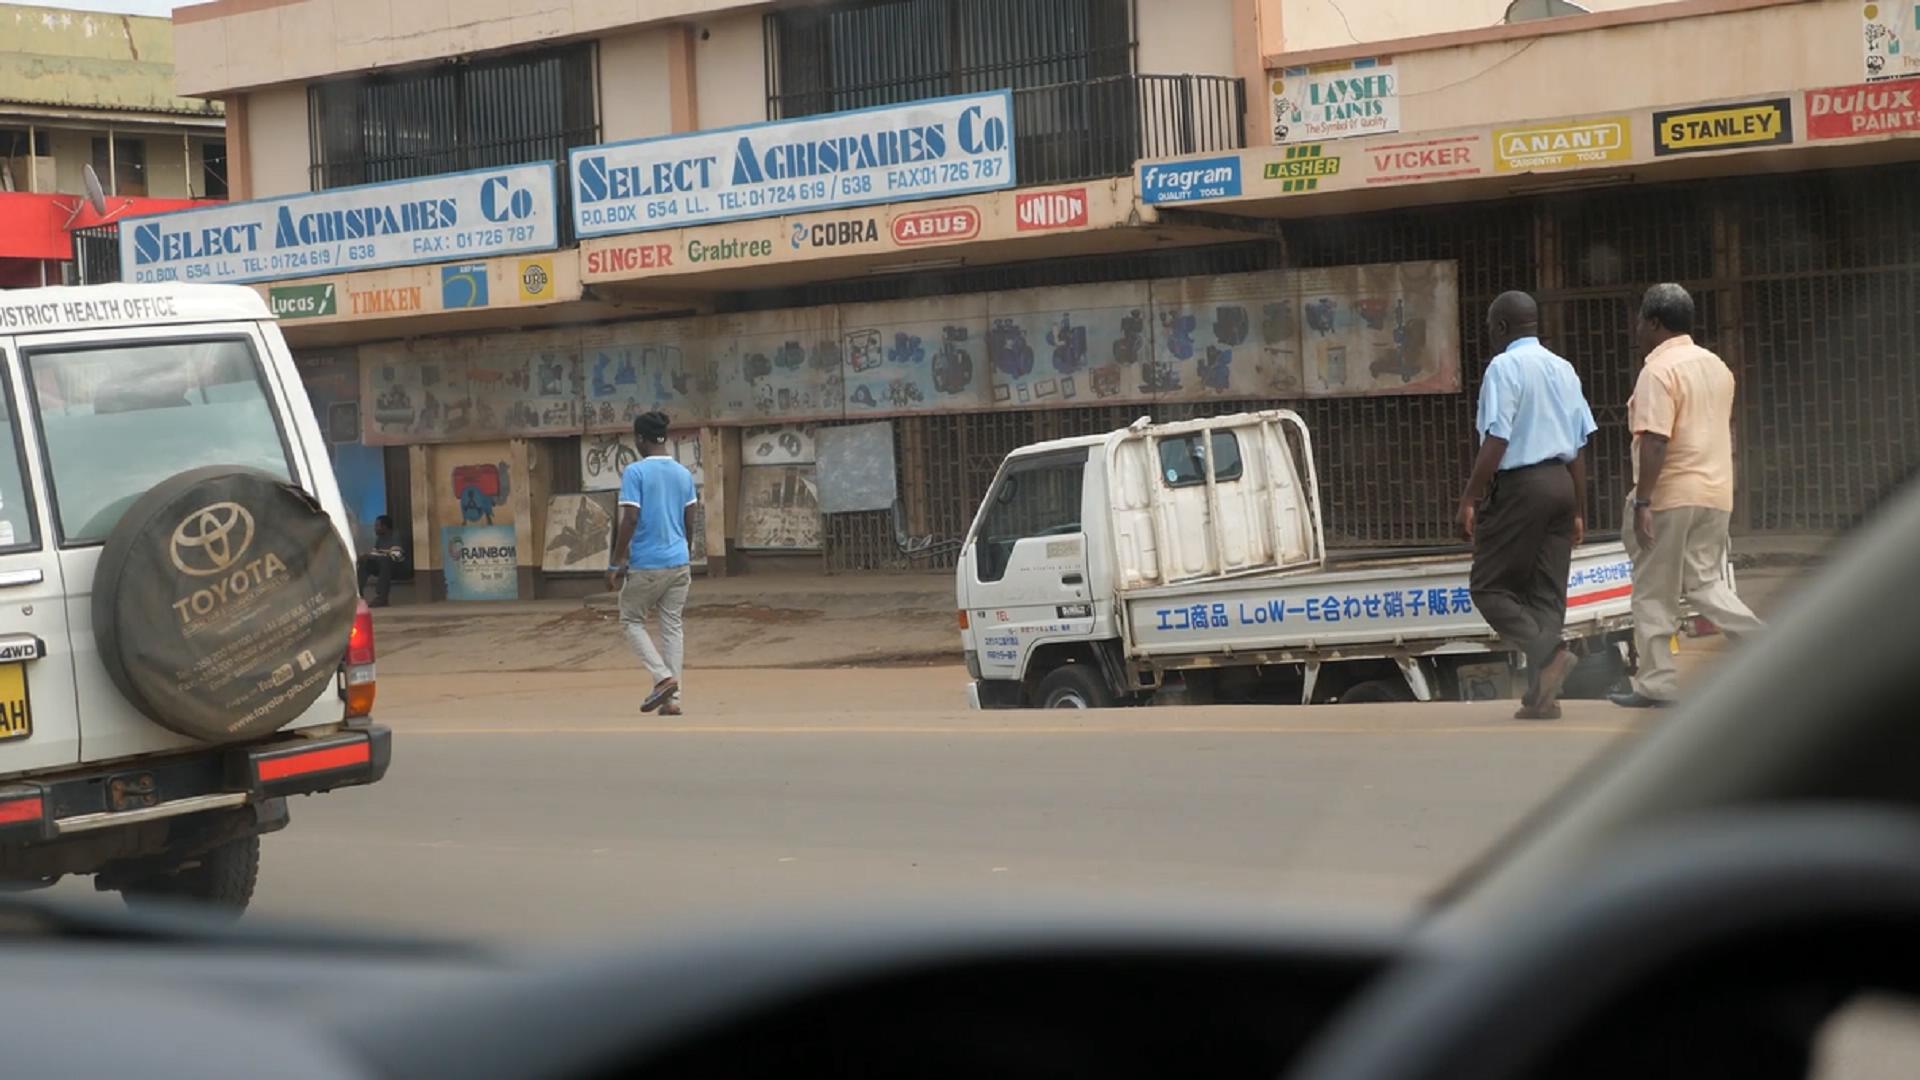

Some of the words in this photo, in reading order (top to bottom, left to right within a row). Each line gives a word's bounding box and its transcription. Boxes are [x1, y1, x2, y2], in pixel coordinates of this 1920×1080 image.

[1310, 74, 1397, 105] LAYSER
[1325, 100, 1382, 121] PAINTS
[1811, 90, 1913, 117] Dulux
[1306, 123, 1321, 134] The
[1671, 113, 1772, 141] STANLEY
[1509, 129, 1610, 154] ANANT
[579, 156, 717, 204] SELECT
[732, 124, 946, 186] AGRISPARES
[1266, 158, 1338, 178] LASHER
[1374, 147, 1470, 172] VICKER
[1510, 154, 1563, 168] CARPENTRY
[1576, 150, 1607, 161] TOOLS
[581, 204, 637, 226] P.O.BOX
[647, 199, 678, 218] 654
[686, 197, 709, 214] LL.
[800, 181, 825, 200] 619
[842, 174, 872, 195] 638
[973, 157, 1002, 179] 787
[1145, 166, 1232, 191] fragram
[1158, 190, 1192, 201] QUALITY
[1200, 187, 1225, 198] TOOLS
[1019, 194, 1082, 226] UNION
[134, 222, 262, 265] SELECT
[275, 198, 457, 249] AGRISPARES
[811, 218, 878, 247] COBRA
[902, 214, 967, 238] ABUS
[186, 264, 210, 279] 654
[217, 261, 235, 276] LL.
[310, 249, 331, 266] 619
[349, 244, 376, 260] 638
[413, 235, 450, 254] FAX:
[508, 224, 535, 243] 787
[587, 243, 673, 274] SINGER
[688, 238, 772, 263] Crabtree
[63, 300, 121, 323] HEALTH
[123, 296, 177, 320] OFFICE
[271, 294, 315, 313] Lucas
[350, 286, 421, 315] TIMKEN
[172, 552, 287, 624] TOYOTA
[1156, 603, 1229, 631] エコ商品
